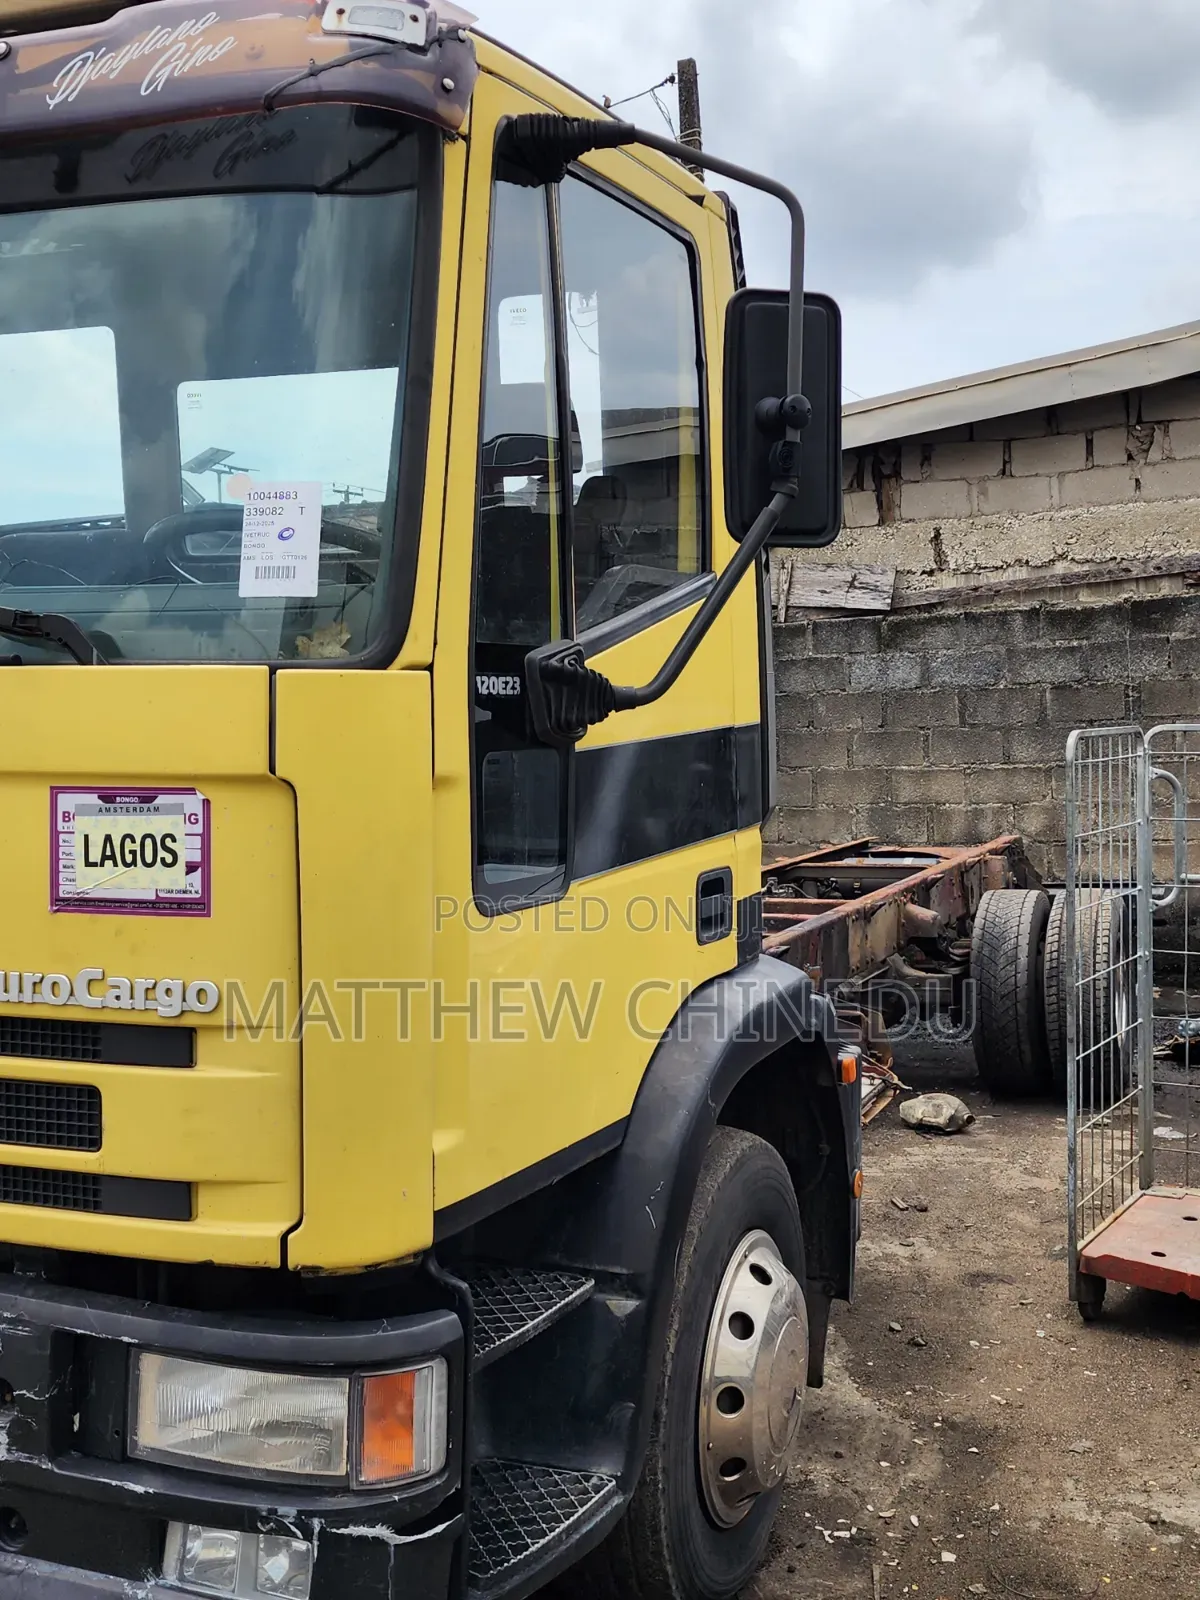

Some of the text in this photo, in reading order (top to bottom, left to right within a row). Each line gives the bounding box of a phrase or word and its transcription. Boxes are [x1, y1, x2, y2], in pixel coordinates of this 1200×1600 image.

[140, 36, 238, 96] Gino
[247, 491, 297, 501] 10044883
[245, 507, 306, 516] 339082 T
[97, 805, 161, 814] AMSTERDAM
[83, 832, 179, 869] LAGOS
